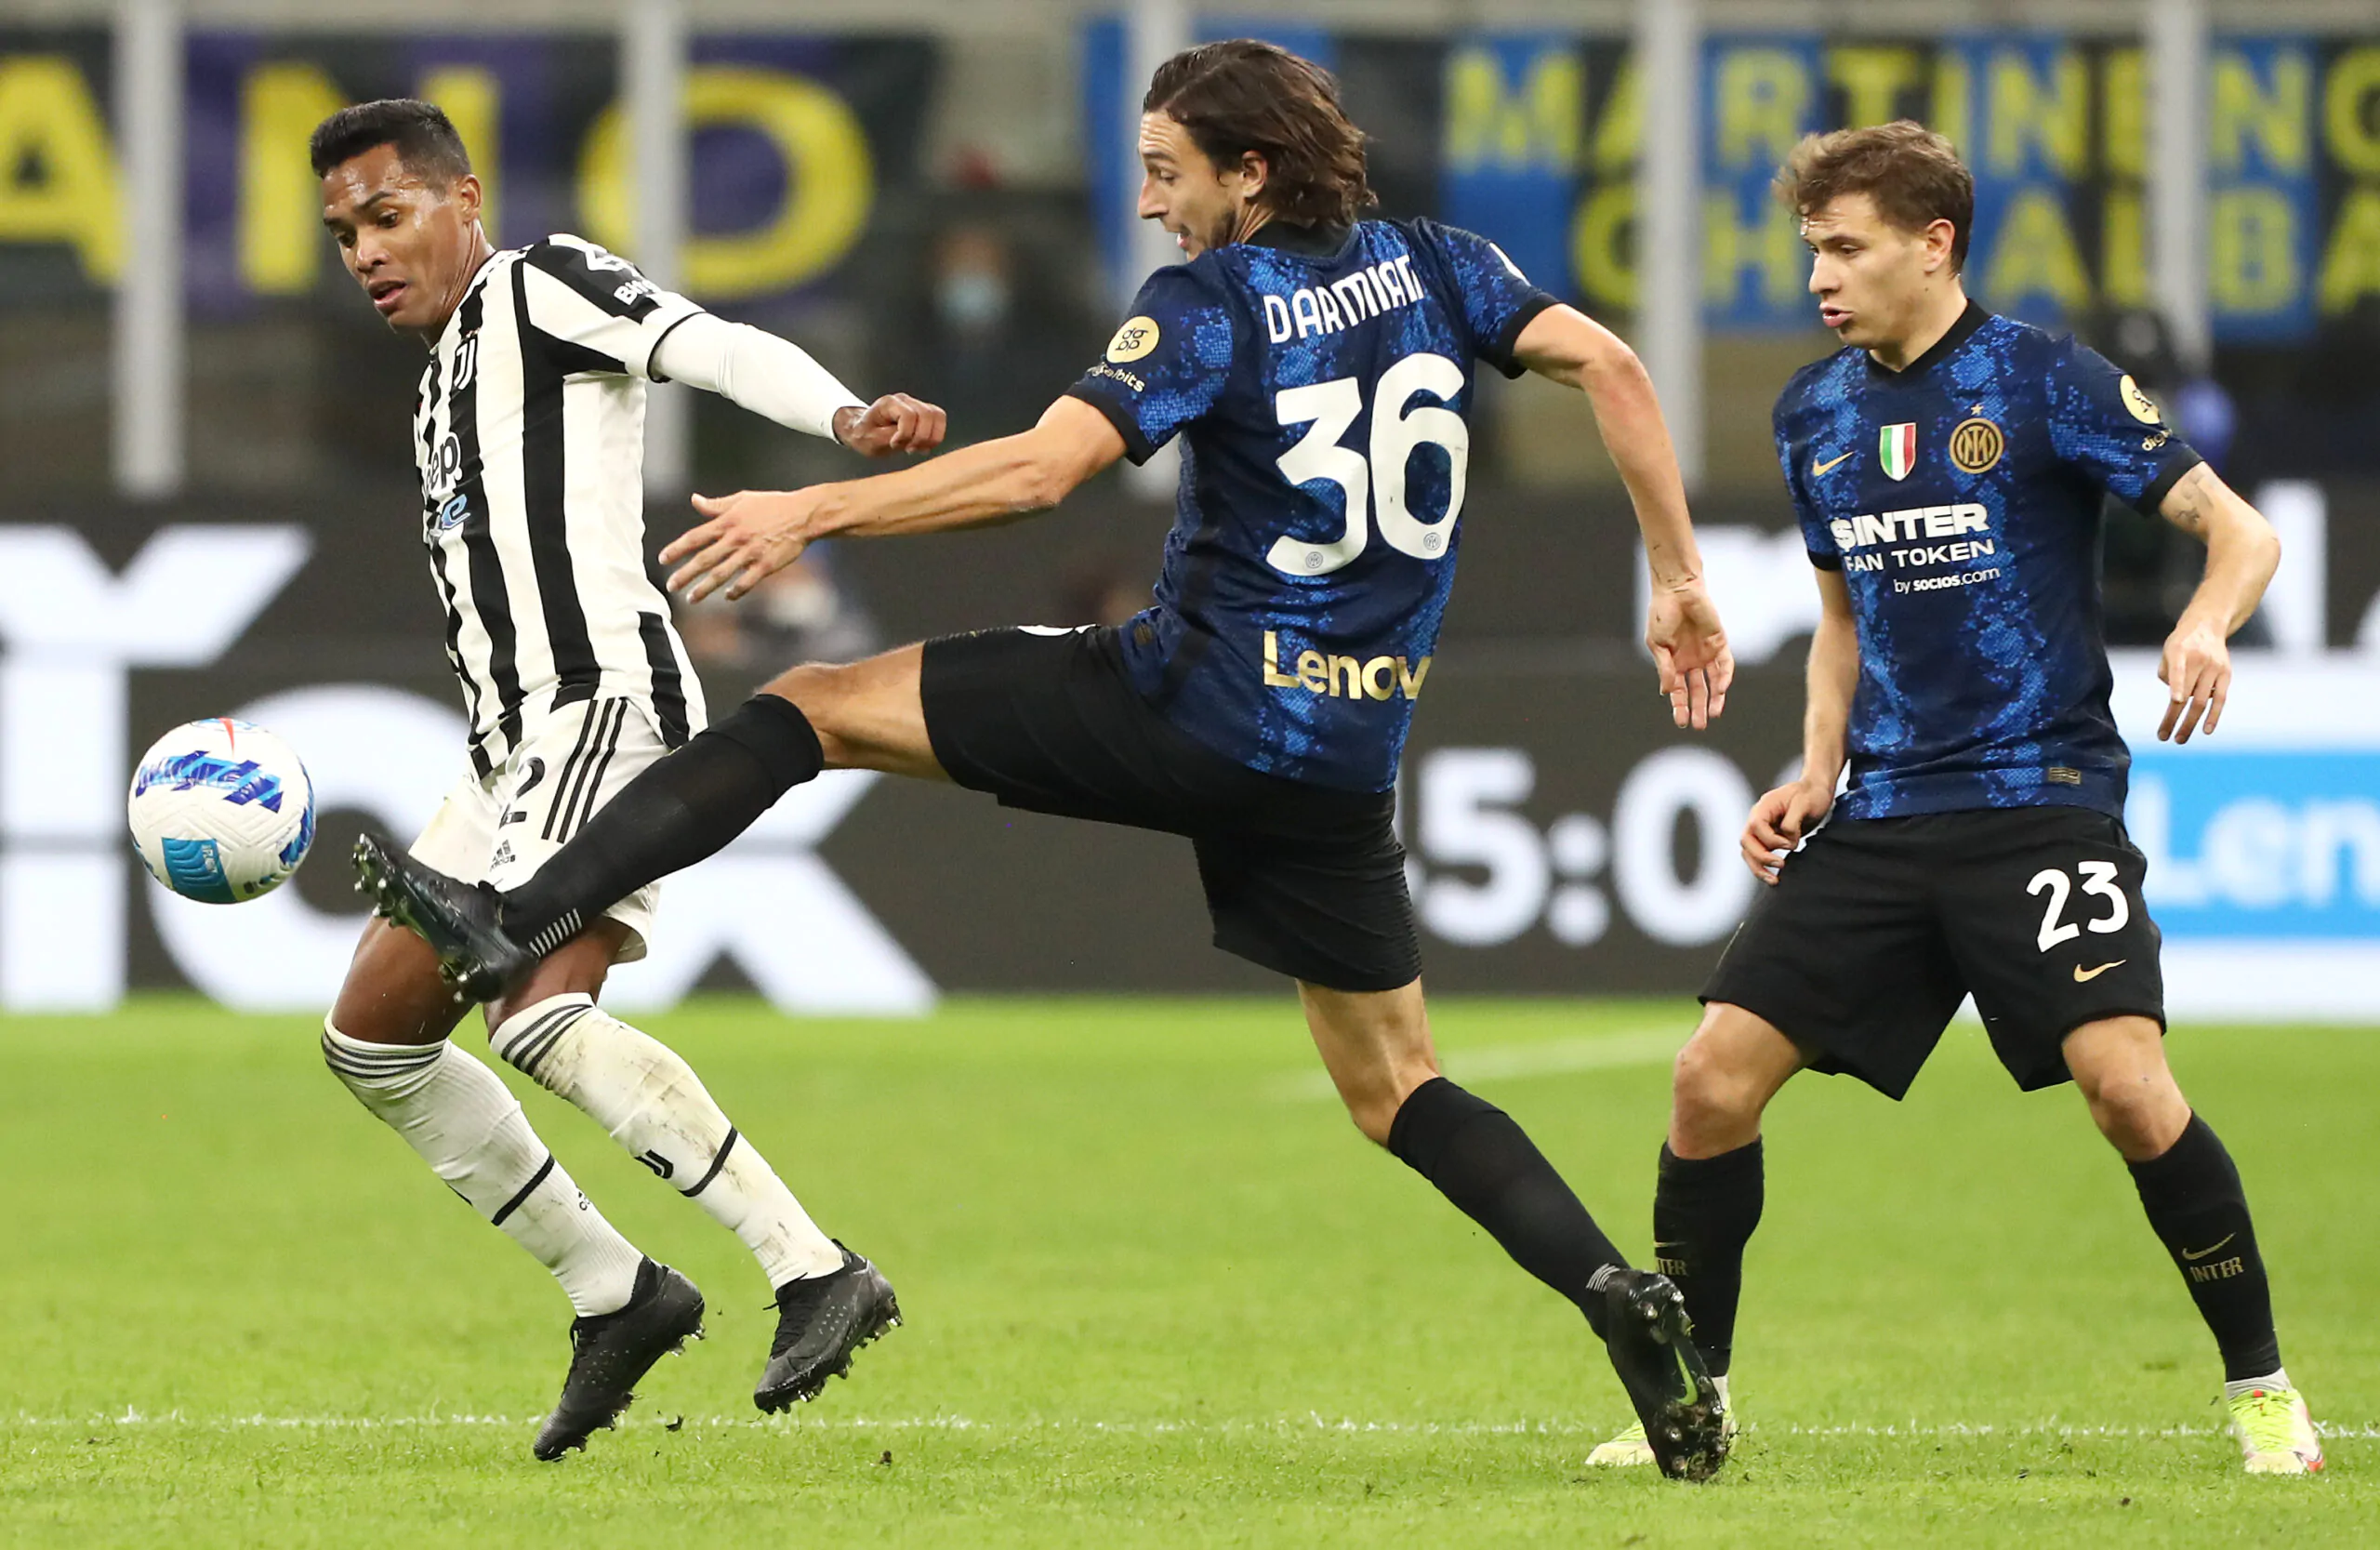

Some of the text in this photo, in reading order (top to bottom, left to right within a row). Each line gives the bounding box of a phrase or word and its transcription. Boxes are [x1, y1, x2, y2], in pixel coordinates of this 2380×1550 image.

[1263, 255, 1424, 344] DARMIAN
[1265, 352, 1470, 576] 36
[1844, 539, 1995, 572] FAN TOKEN
[1894, 578, 1911, 595] by
[2026, 859, 2130, 954] 23
[2189, 1256, 2244, 1283] INTER
